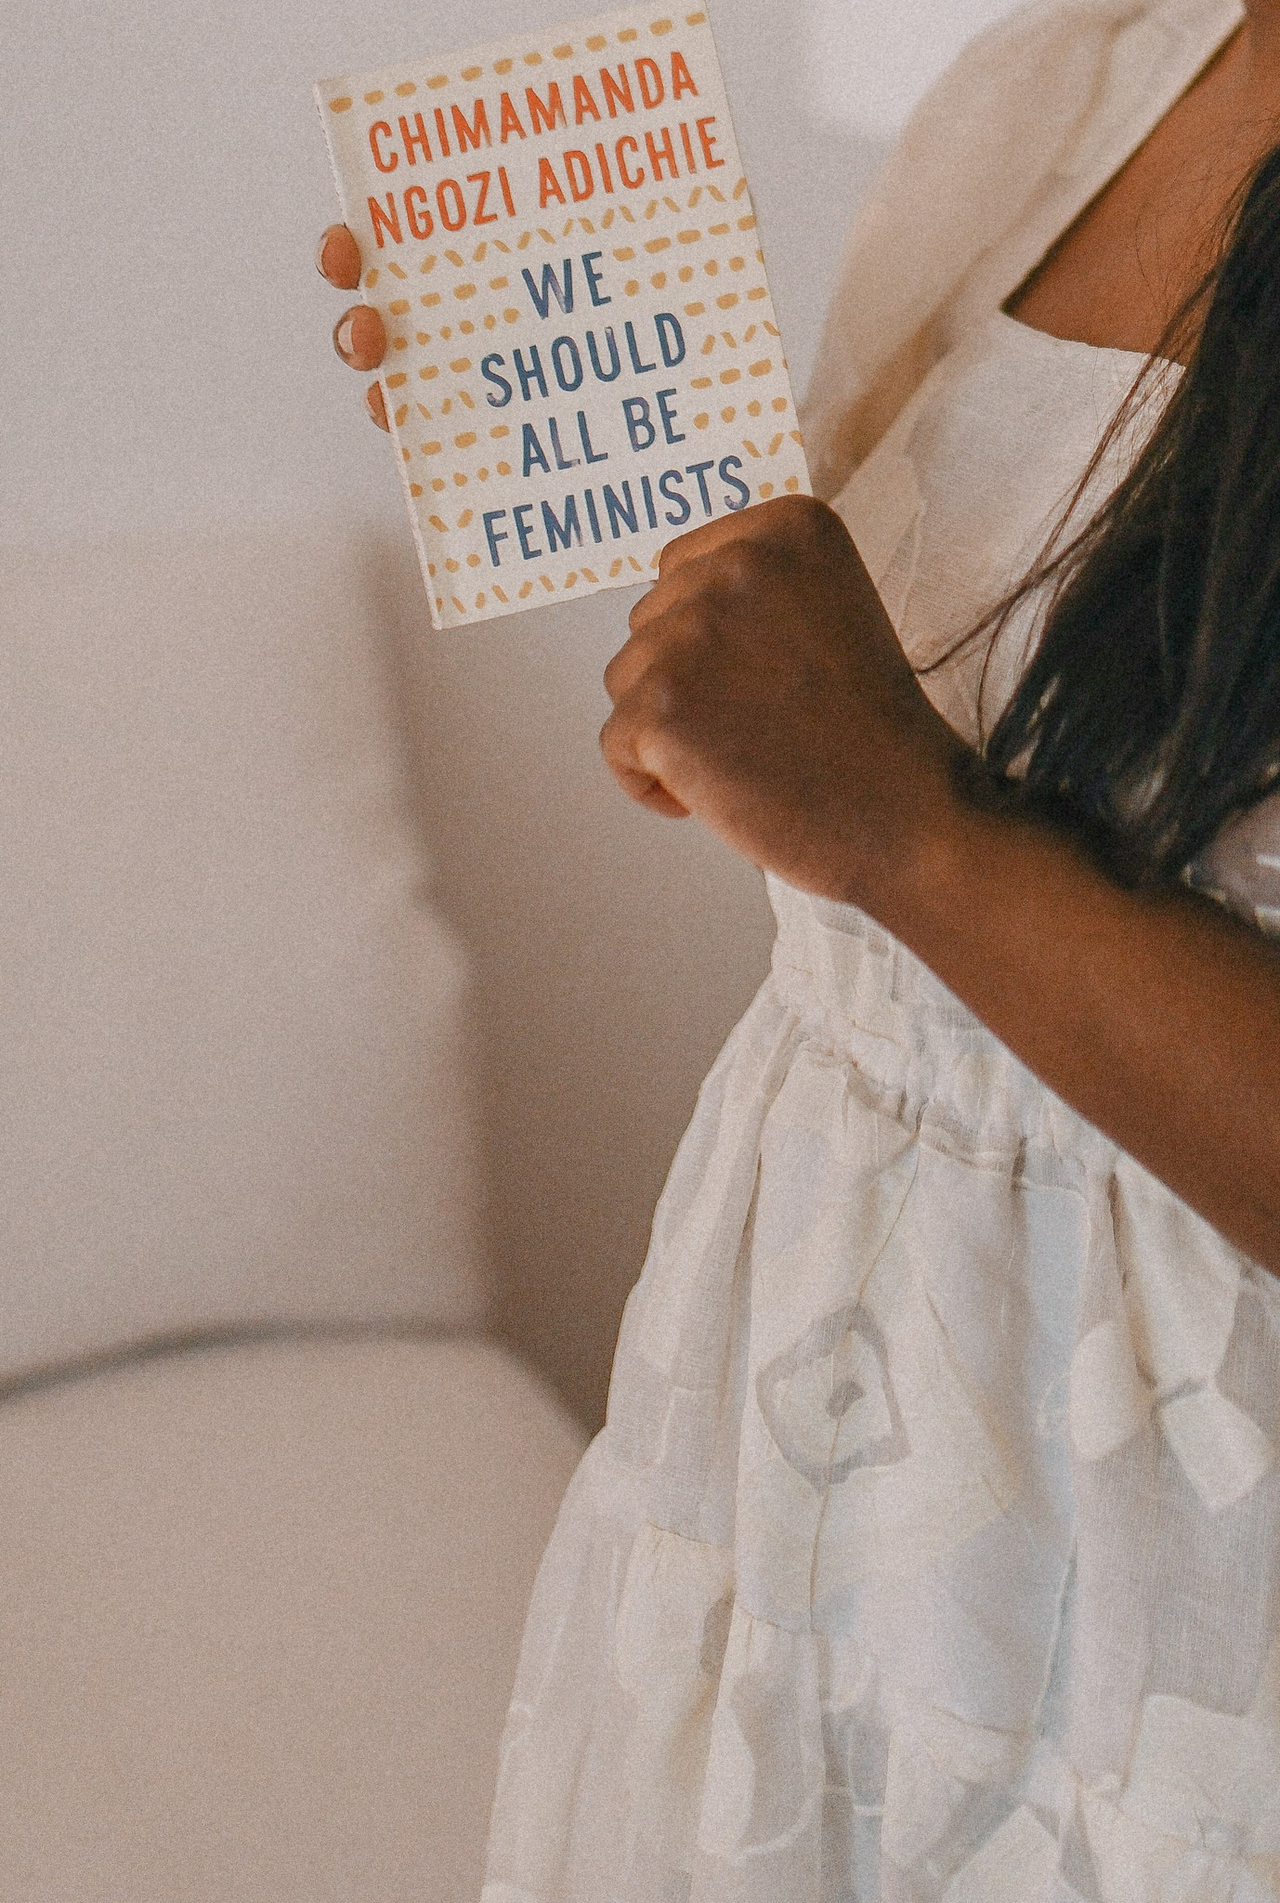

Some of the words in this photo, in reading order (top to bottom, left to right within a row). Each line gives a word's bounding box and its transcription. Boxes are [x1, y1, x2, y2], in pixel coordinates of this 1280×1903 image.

[368, 51, 699, 173] CHIMAMANDA
[367, 166, 517, 249] NGOZI
[538, 116, 725, 209] ADICHIE
[521, 251, 612, 320] WE
[480, 311, 687, 408] SHOULD
[521, 410, 608, 477] ALL
[621, 388, 686, 453] BE
[482, 455, 751, 567] FEMINISTS
